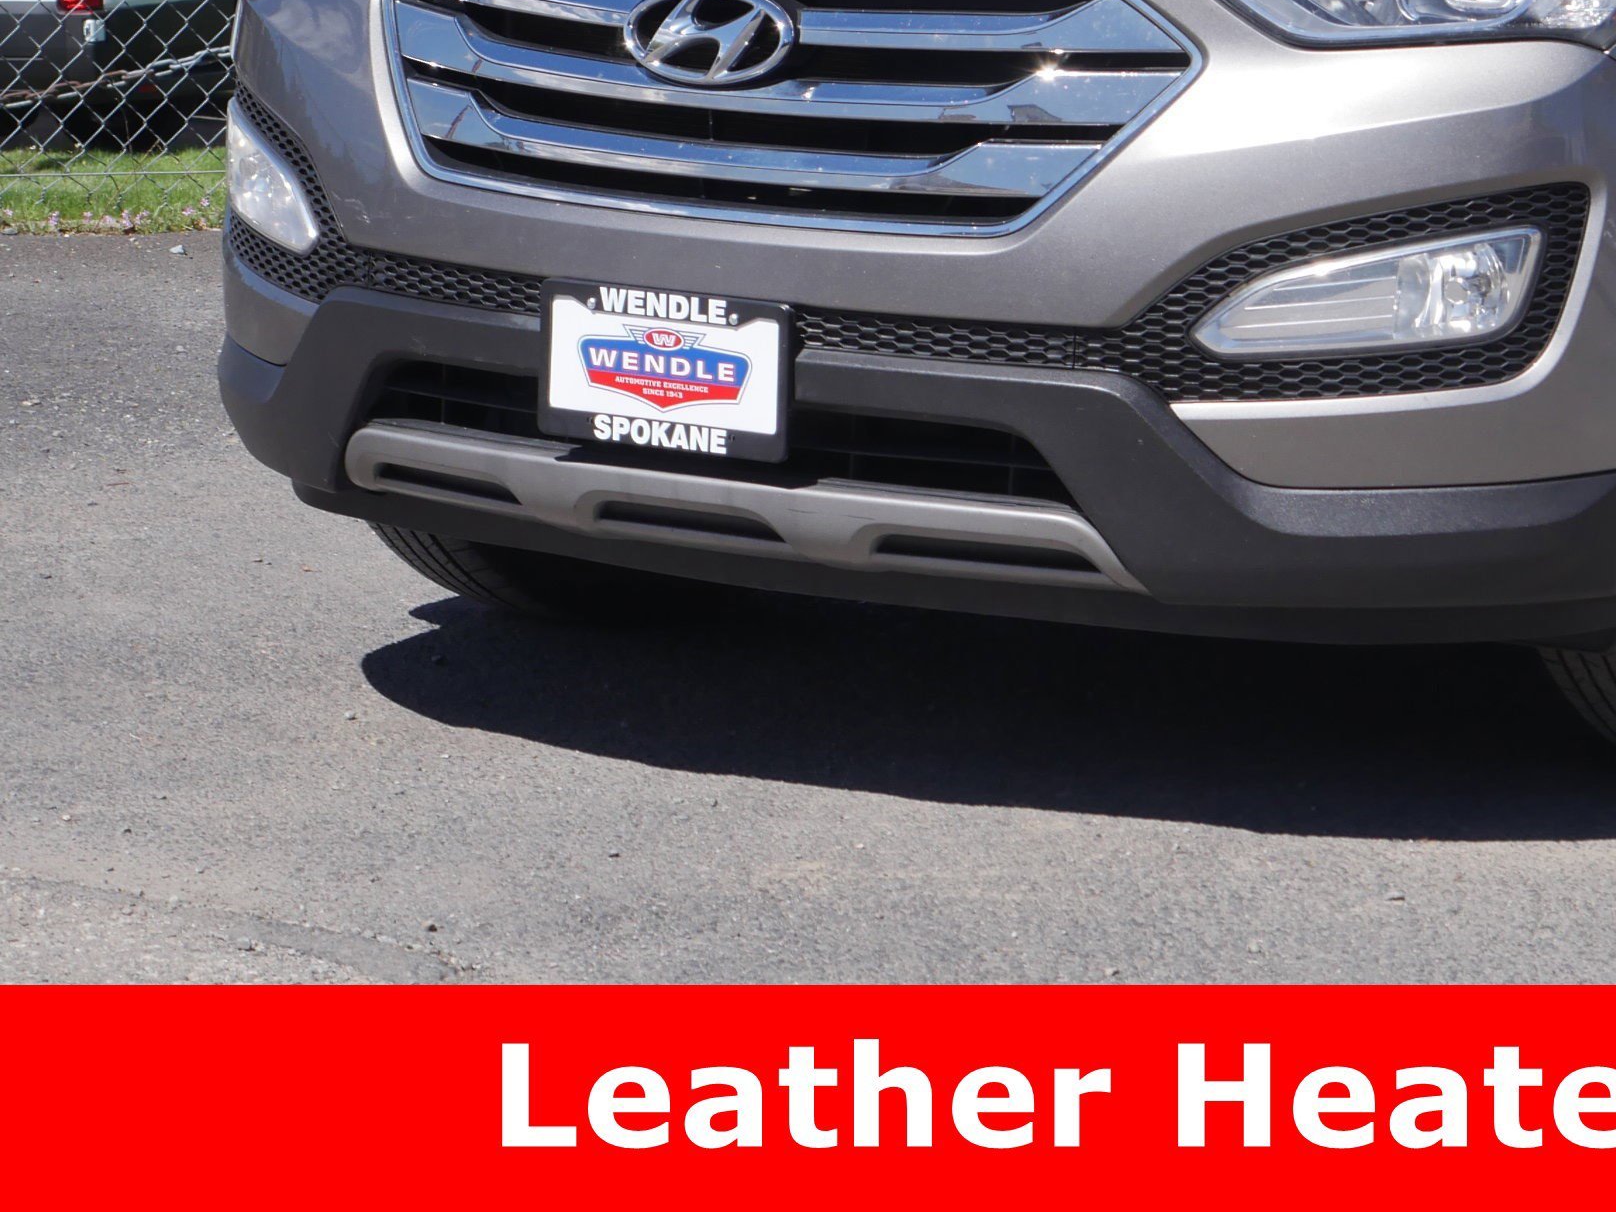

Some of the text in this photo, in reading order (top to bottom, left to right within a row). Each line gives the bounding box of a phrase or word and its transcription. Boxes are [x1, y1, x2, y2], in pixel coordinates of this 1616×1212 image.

[600, 287, 727, 325] WENDLE
[589, 347, 735, 382] WENDLE
[615, 376, 709, 393] AUTOMOTIVE EXCELLENCE
[642, 388, 665, 397] SINCE
[593, 414, 727, 455] SPOKANE
